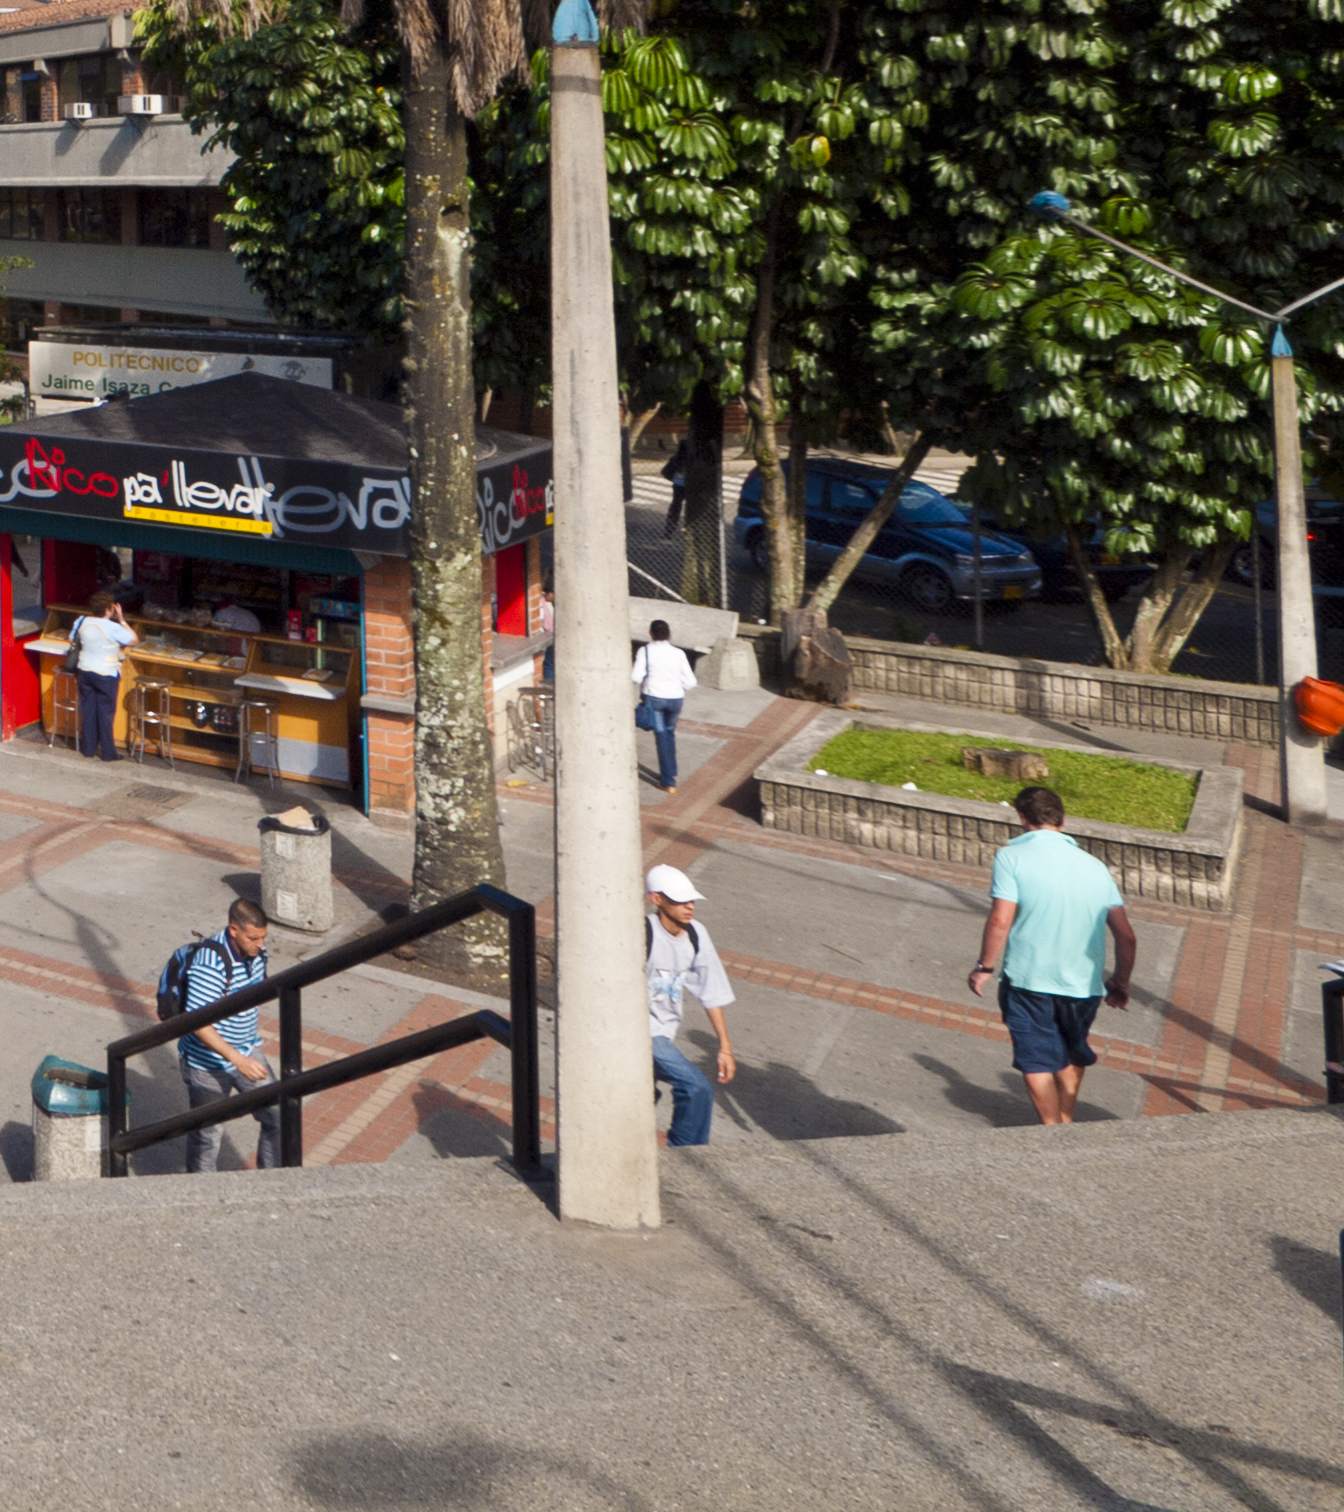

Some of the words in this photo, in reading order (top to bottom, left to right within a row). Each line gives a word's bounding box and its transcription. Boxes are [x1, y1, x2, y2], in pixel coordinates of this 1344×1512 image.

[72, 350, 201, 374] POLITECNICO
[41, 374, 95, 392] Jaime
[102, 377, 151, 396] Isaza
[25, 437, 119, 498] Rico
[237, 457, 411, 539] lleva
